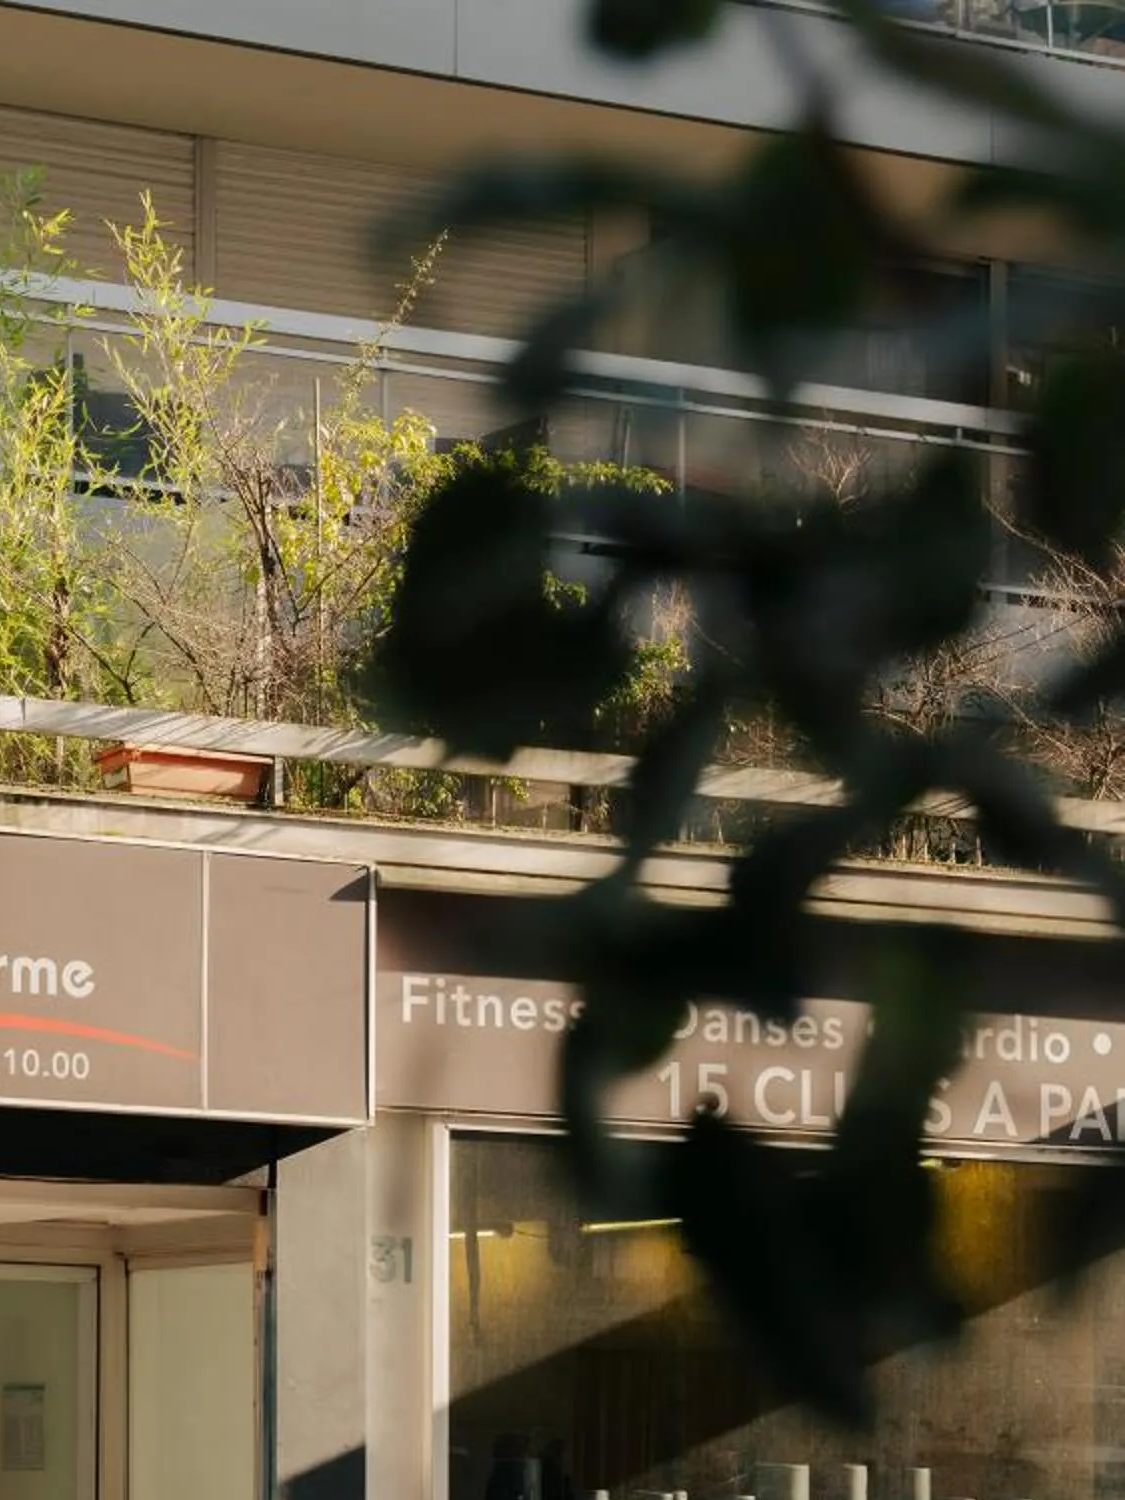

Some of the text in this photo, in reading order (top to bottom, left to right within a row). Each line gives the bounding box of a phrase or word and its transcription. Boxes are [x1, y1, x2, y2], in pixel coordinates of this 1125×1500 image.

[960, 1013, 1071, 1064] rdio
[659, 1060, 729, 1120] 15
[1040, 1083, 1125, 1141] PA
[369, 1235, 413, 1285] 31
